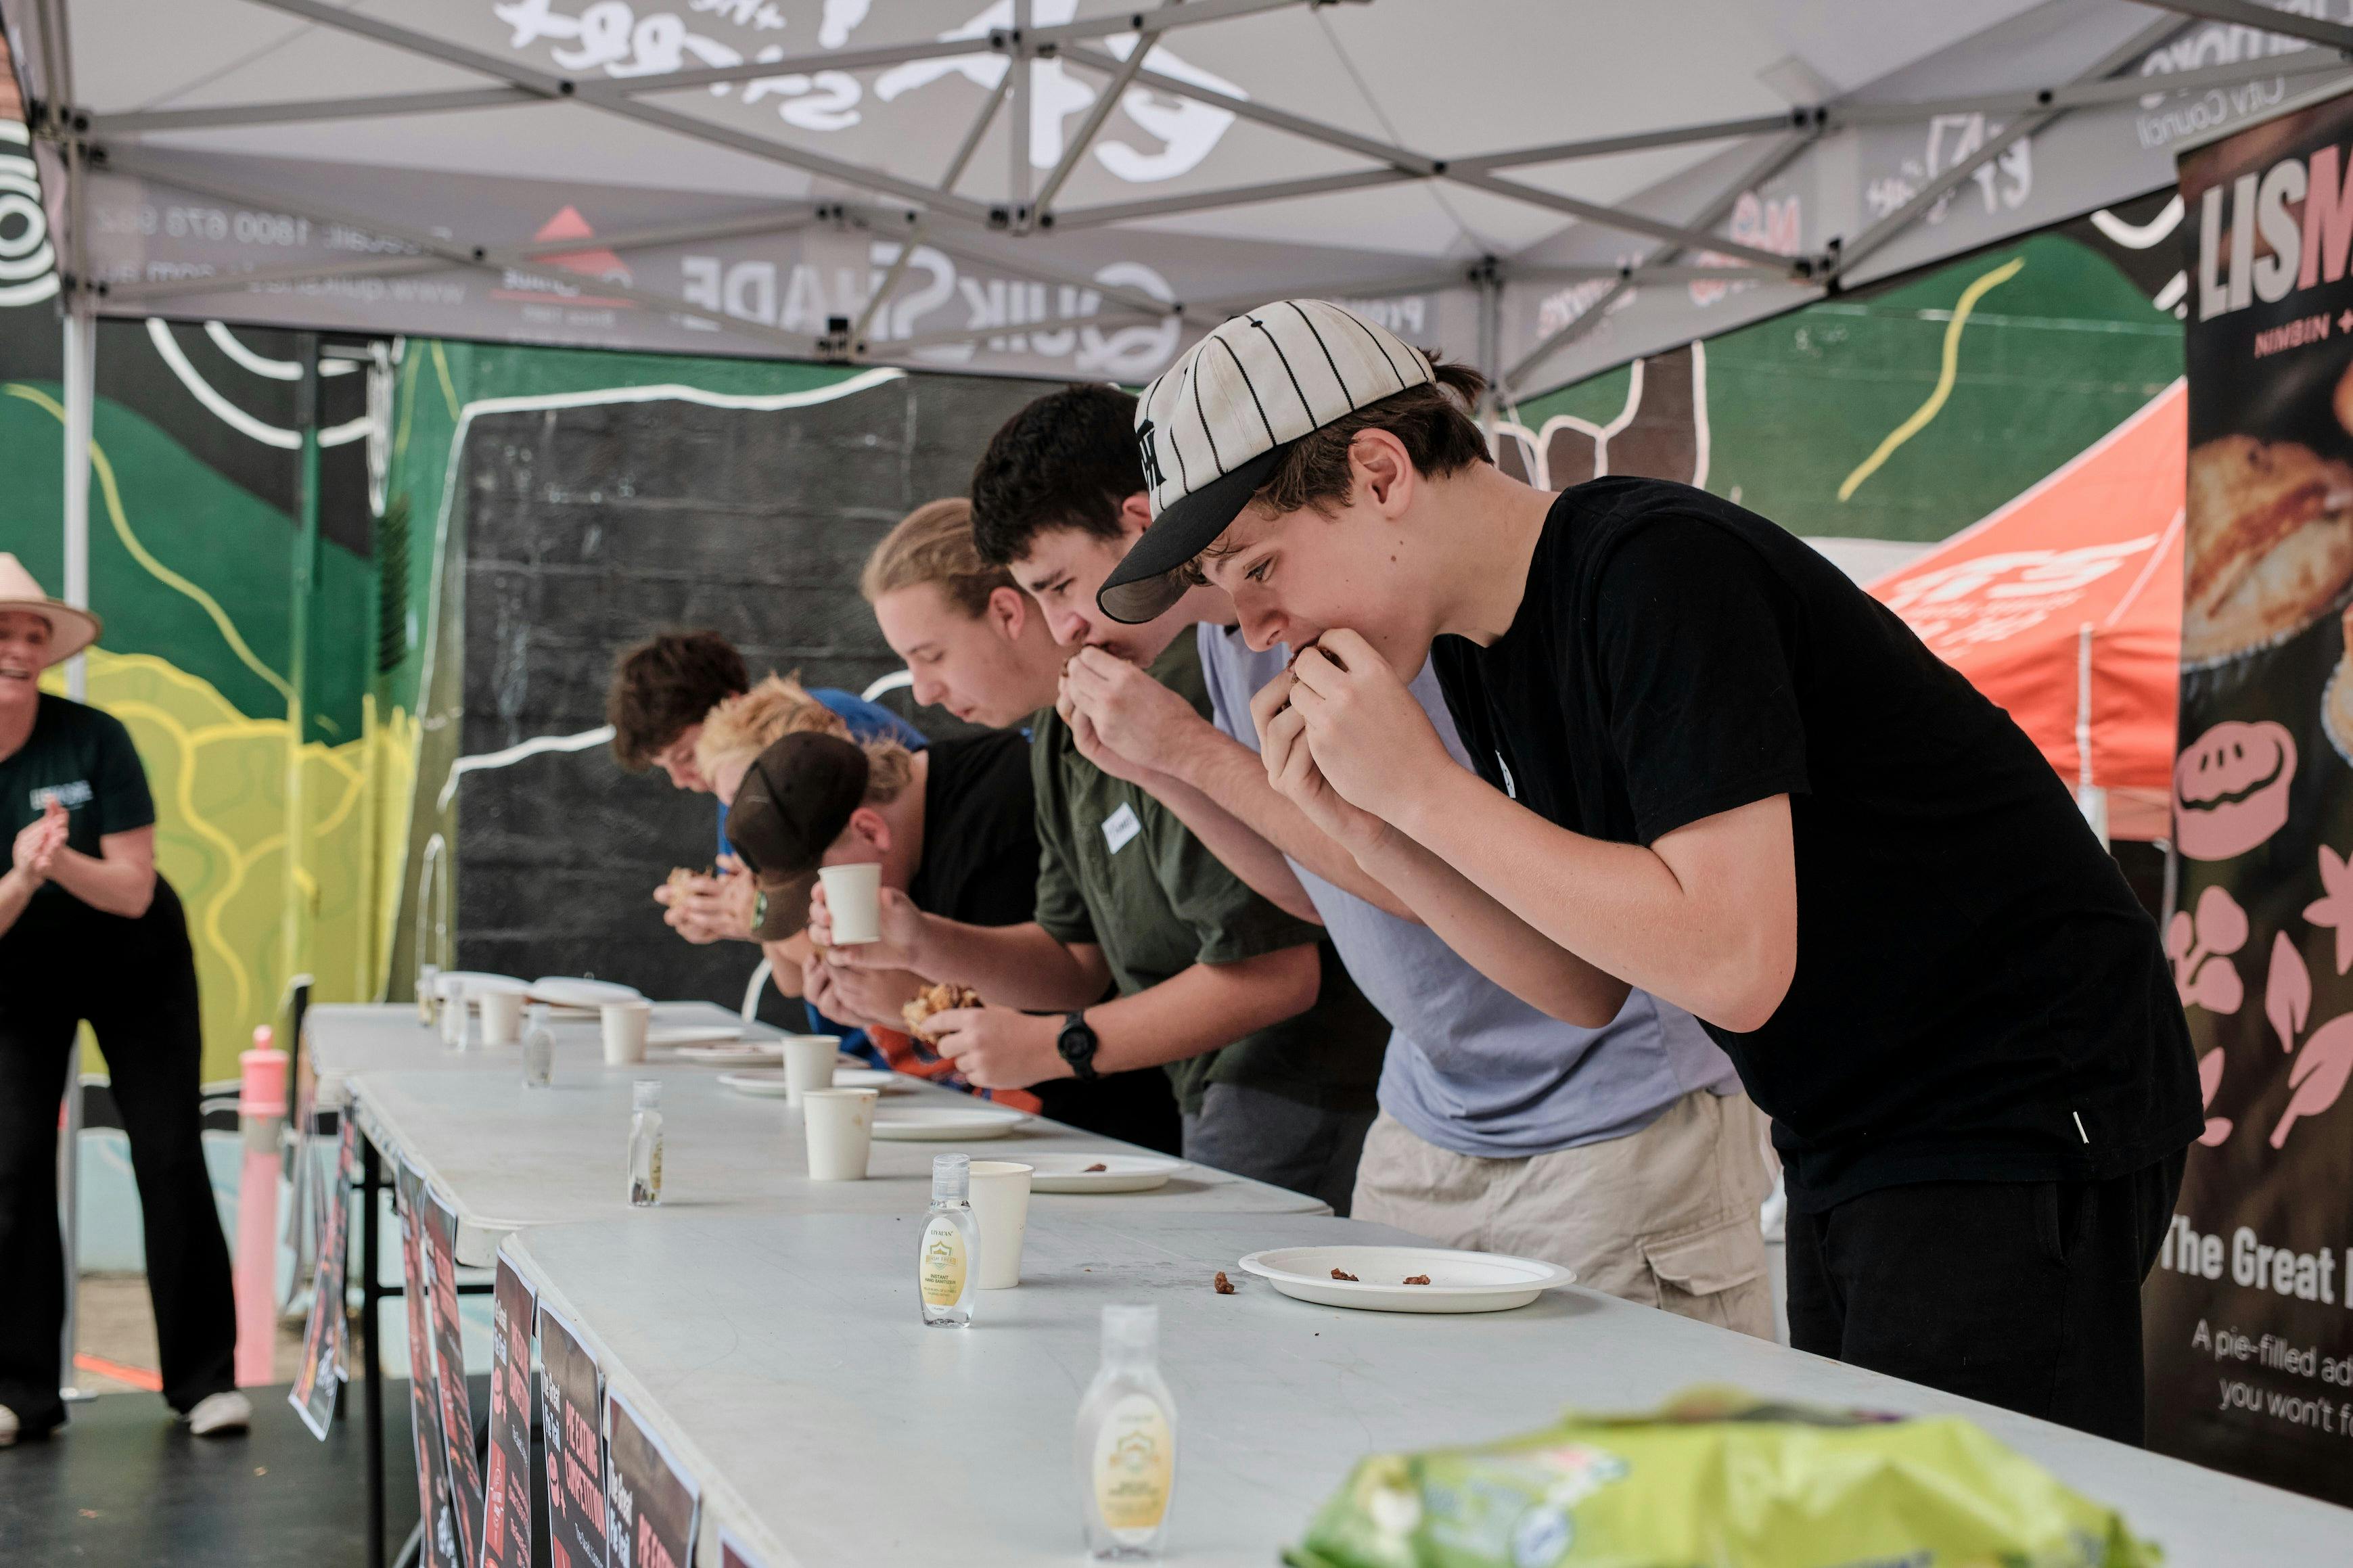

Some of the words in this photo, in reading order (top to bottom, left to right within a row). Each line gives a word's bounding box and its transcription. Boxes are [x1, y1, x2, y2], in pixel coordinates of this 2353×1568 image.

[2233, 1226, 2336, 1306] Great
[2191, 1319, 2212, 1352] A
[2214, 1325, 2318, 1379] pie-filled
[2218, 1377, 2264, 1411] you
[2265, 1390, 2334, 1433] won't
